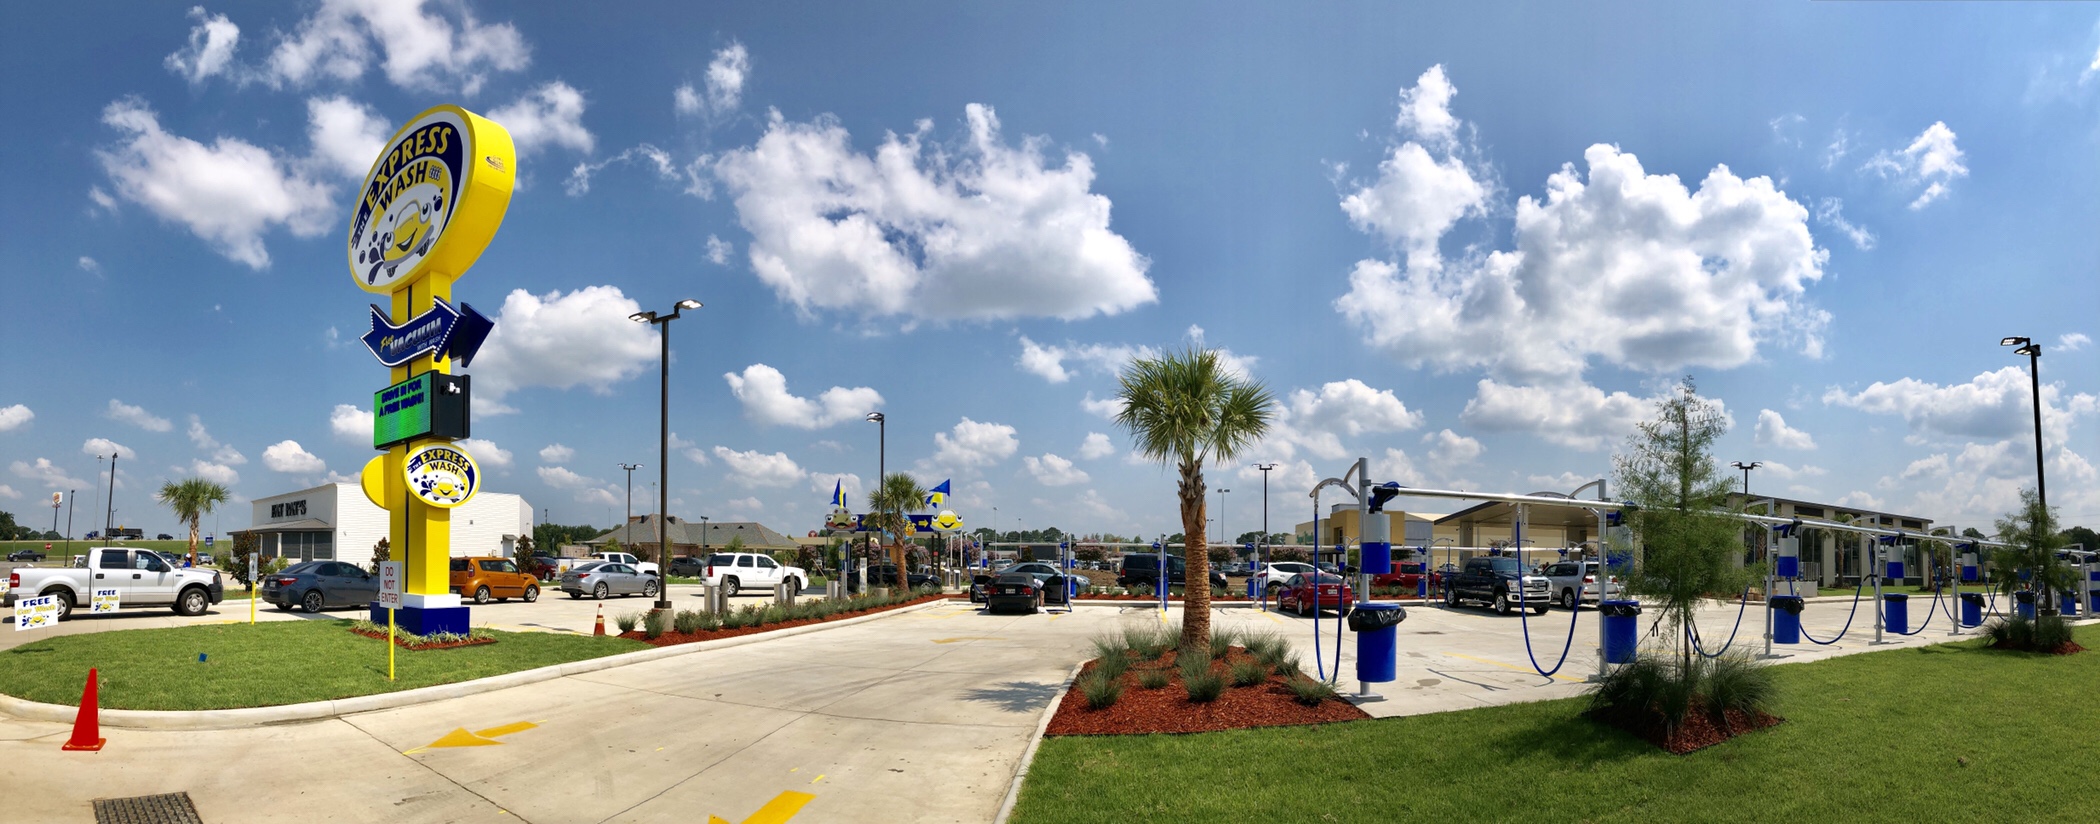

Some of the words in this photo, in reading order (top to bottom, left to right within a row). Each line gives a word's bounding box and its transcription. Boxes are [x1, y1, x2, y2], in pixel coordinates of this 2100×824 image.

[365, 125, 452, 211] EXPRESS
[379, 160, 428, 212] WASH
[390, 317, 442, 356] VACUUM
[382, 387, 399, 404] DRIVE
[400, 384, 407, 397] IN
[408, 378, 422, 394] FOR
[379, 406, 384, 417] A
[384, 401, 400, 415] FREE
[420, 449, 470, 471] EXPRESS
[429, 461, 459, 475] WASH
[385, 566, 394, 577] DO
[383, 580, 395, 589] NOT
[22, 597, 51, 607] FREE
[381, 592, 398, 603] ENTER
[17, 607, 32, 616] Car
[34, 603, 56, 613] Wash
